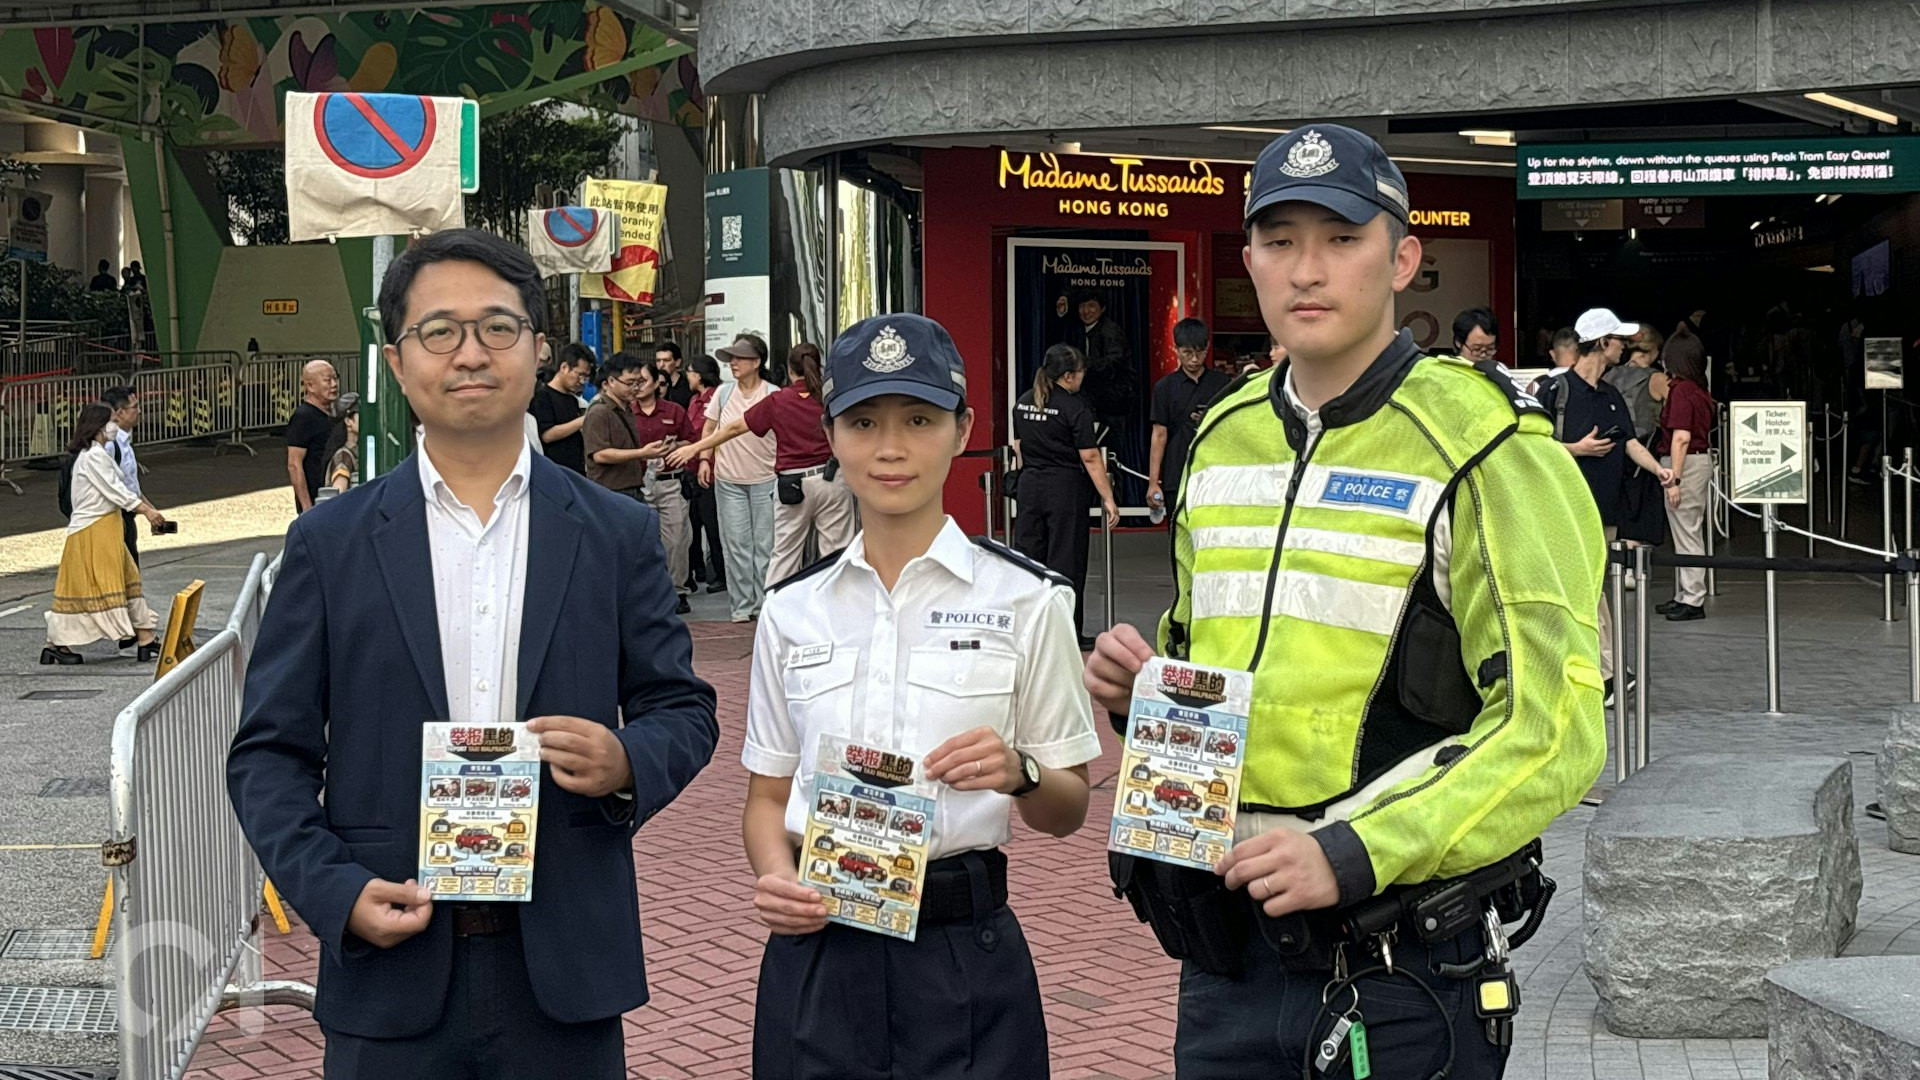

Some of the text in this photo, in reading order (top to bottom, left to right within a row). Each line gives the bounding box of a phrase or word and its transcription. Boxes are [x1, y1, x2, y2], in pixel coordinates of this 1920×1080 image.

[1527, 149, 1890, 169] Up for the skyline, down without the queues using Peak Tram Easy Queue!
[999, 150, 1118, 191] Madame
[1109, 158, 1225, 195] Tussauds
[1059, 199, 1169, 217] HONG KONG
[621, 215, 655, 229] orarily
[1408, 210, 1470, 226] OUNTER
[620, 229, 651, 240] ended
[1042, 253, 1152, 275] Madame Tussauds
[1070, 278, 1126, 287] HONG KONG
[1765, 409, 1787, 417] Ticket
[1742, 439, 1763, 447] Ticket
[1741, 448, 1776, 456] Purchase
[1343, 482, 1393, 499] POLICE
[1393, 487, 1410, 502] 察
[931, 610, 1011, 629] 警 POLICE 察
